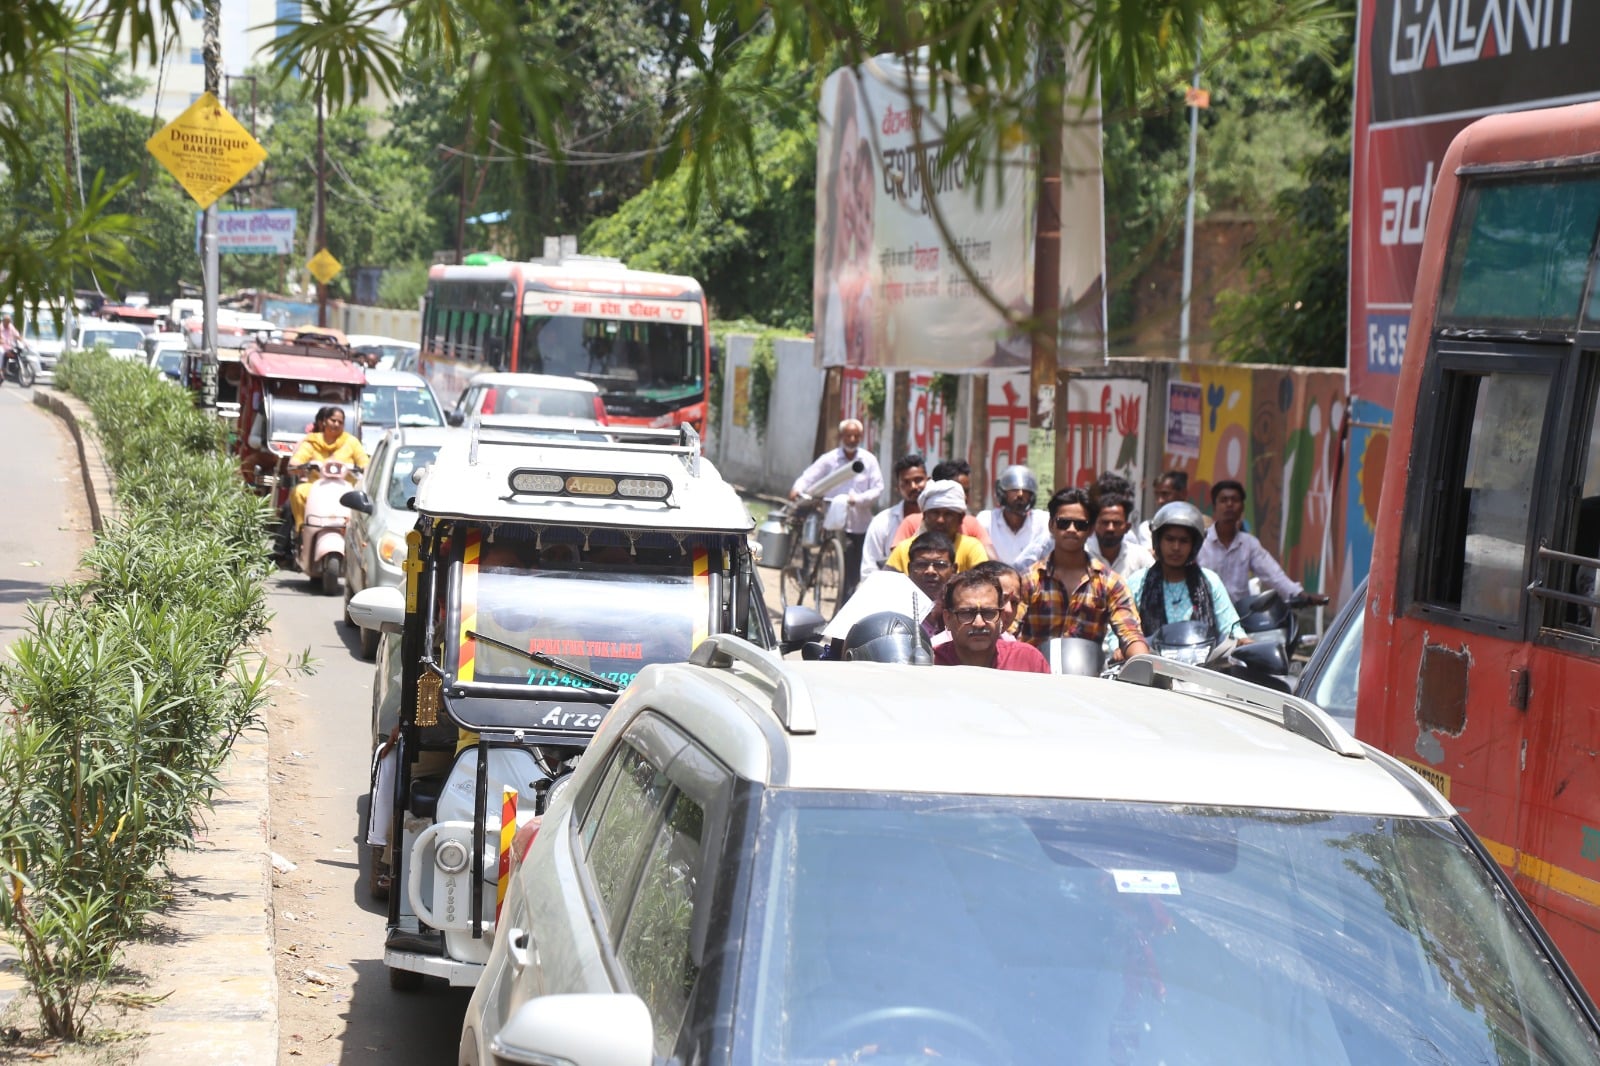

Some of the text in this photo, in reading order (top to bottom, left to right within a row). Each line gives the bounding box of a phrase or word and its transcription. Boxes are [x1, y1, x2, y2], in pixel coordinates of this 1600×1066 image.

[171, 129, 249, 151] Dominique
[183, 143, 224, 156] BAKERS
[1369, 323, 1386, 365] Fe
